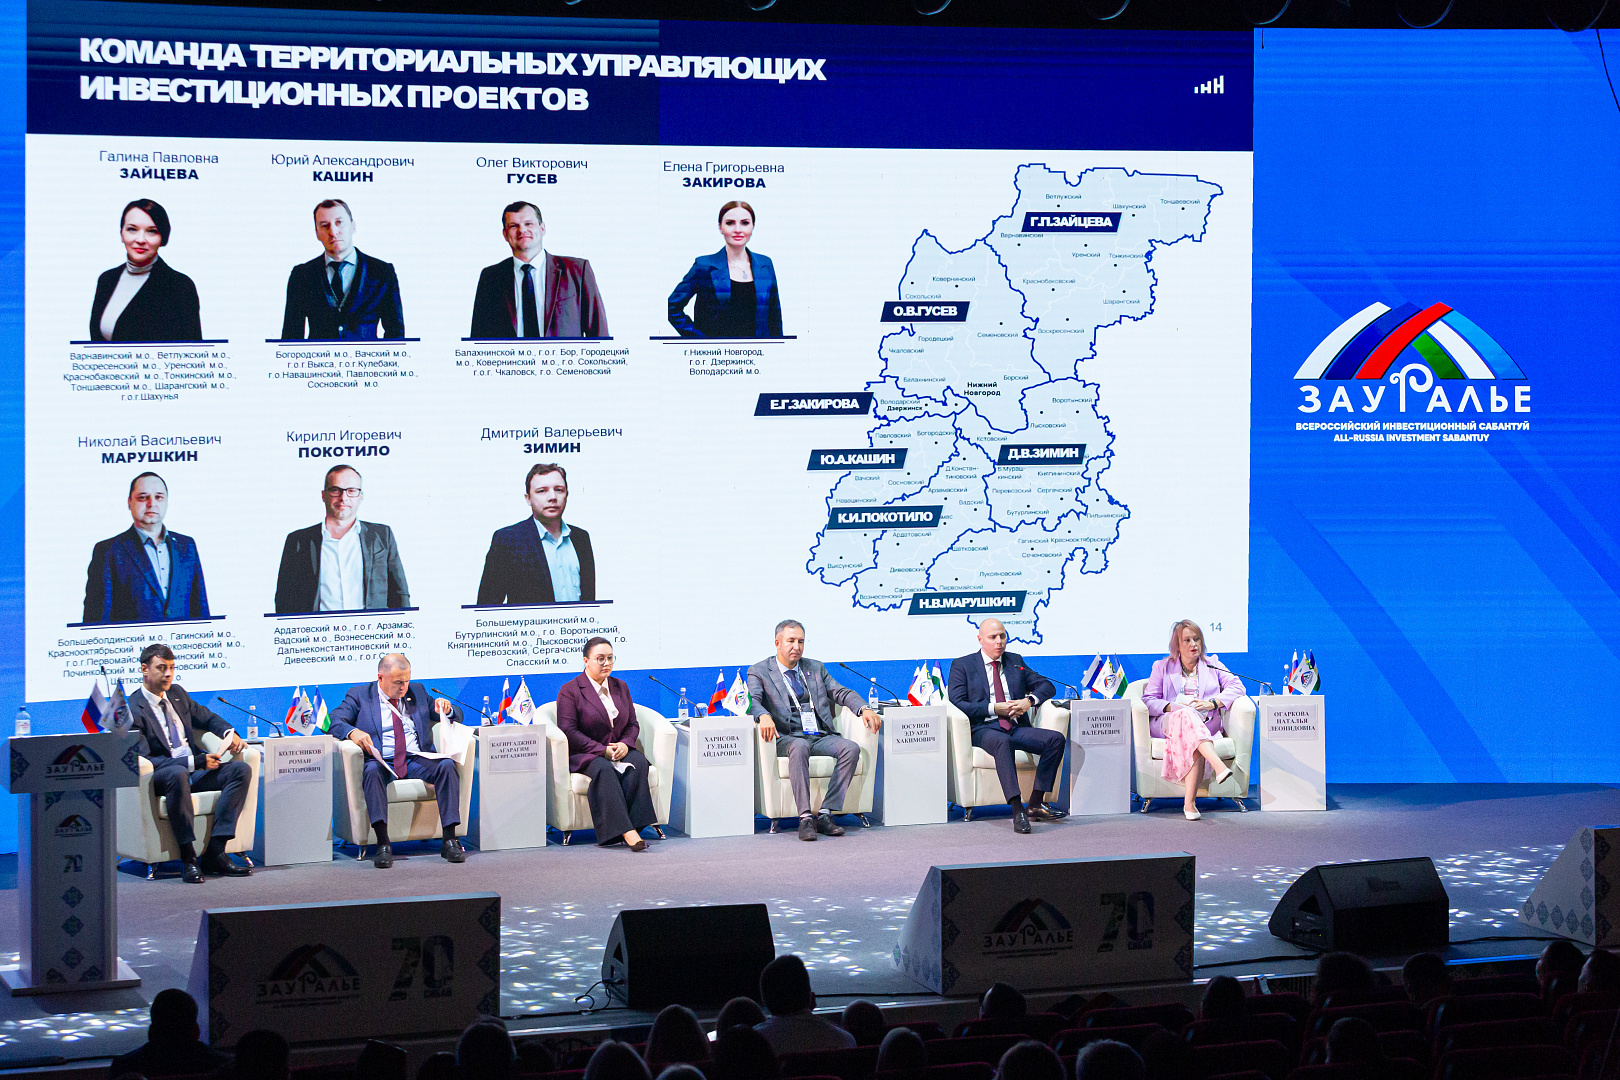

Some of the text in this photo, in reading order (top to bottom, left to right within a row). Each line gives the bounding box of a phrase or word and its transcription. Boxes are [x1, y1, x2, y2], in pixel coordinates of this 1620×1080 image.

[79, 38, 828, 84] КОМАНДА ТЕРРИТОРИАЛЬНЫХ УПРАВЛЯЮЩИХ
[79, 75, 590, 111] ИНВЕСТИЦИОННЫХ ПРОЕКТОВ
[100, 151, 218, 163] Галина Павловна
[272, 154, 414, 167] Юрий Александрович
[476, 157, 587, 170] Олег Викторович
[664, 161, 784, 174] Елена Григорьевна
[120, 166, 199, 180] ЗАЙЦЕВА
[313, 171, 373, 182] КАШИН
[507, 174, 557, 184] ГУСЕВ
[683, 177, 766, 188] ЗАКИРОВА
[1029, 215, 1113, 228] Г.П.ЗАЙЦЕВА
[892, 305, 958, 317] О.В.ГУСЕВ
[70, 351, 209, 360] Варнавинский Ветлужский
[276, 350, 330, 359] Богородский
[561, 349, 578, 357] Бор,
[581, 348, 629, 356] Городецкий
[72, 362, 138, 370] Воскресенский
[477, 358, 535, 366] Ковернинский
[711, 358, 755, 366] Дзержинск,
[63, 373, 139, 381] Краснобаковский
[556, 367, 611, 375] Семеновский
[690, 368, 743, 376] Володарский
[71, 382, 207, 391] Тоншаевский Шарангский
[308, 380, 358, 388] Сосновский
[1297, 363, 1531, 413] ЗАУРАЛЬЕ
[769, 398, 861, 410] Е.Г.ЗАКИРОВА
[1296, 420, 1530, 432] ВСЕРОССИЙСКИЙ ИНВЕСТИЦИОННЫЙ САБАНТУЙ
[287, 430, 401, 442] Кирилл Игоревич
[481, 427, 622, 441] Дмитрий Валерьевич
[1334, 433, 1489, 442] ALL-RUSSIA INVESTMENT SABANTUY
[79, 435, 221, 447] Николай Васильевич
[299, 445, 390, 458] ПОКОТИЛО
[524, 443, 580, 453] ЗИМИН
[1007, 448, 1079, 460] Д.В.ЗИМИН
[102, 451, 197, 463] МАРУШКИН
[820, 454, 896, 465] Ю.А.КАШИН
[837, 511, 934, 523] К.И.ПОКОТИЛО
[918, 596, 1017, 609] Н.В.МАРУШКИН
[476, 618, 578, 627] Большемурашкинский
[1210, 622, 1222, 631] 14
[274, 625, 330, 635] Ардатовский
[456, 626, 620, 640] Бутурлинский Воротынский,
[58, 635, 145, 647] Большеболдинский
[274, 632, 393, 645] Вадский Вознесенский
[448, 637, 590, 650] Княгининский Лысковский
[48, 646, 135, 658] Краснооктябрьский
[276, 642, 390, 655] Дальнеконстантиновский
[468, 648, 529, 657] Перевозский,
[284, 655, 335, 665] Дивеевский
[507, 658, 549, 666] Спасский
[279, 749, 321, 757] КОЛЕСНИКОВ
[702, 750, 742, 758] АЙДАРОВНА
